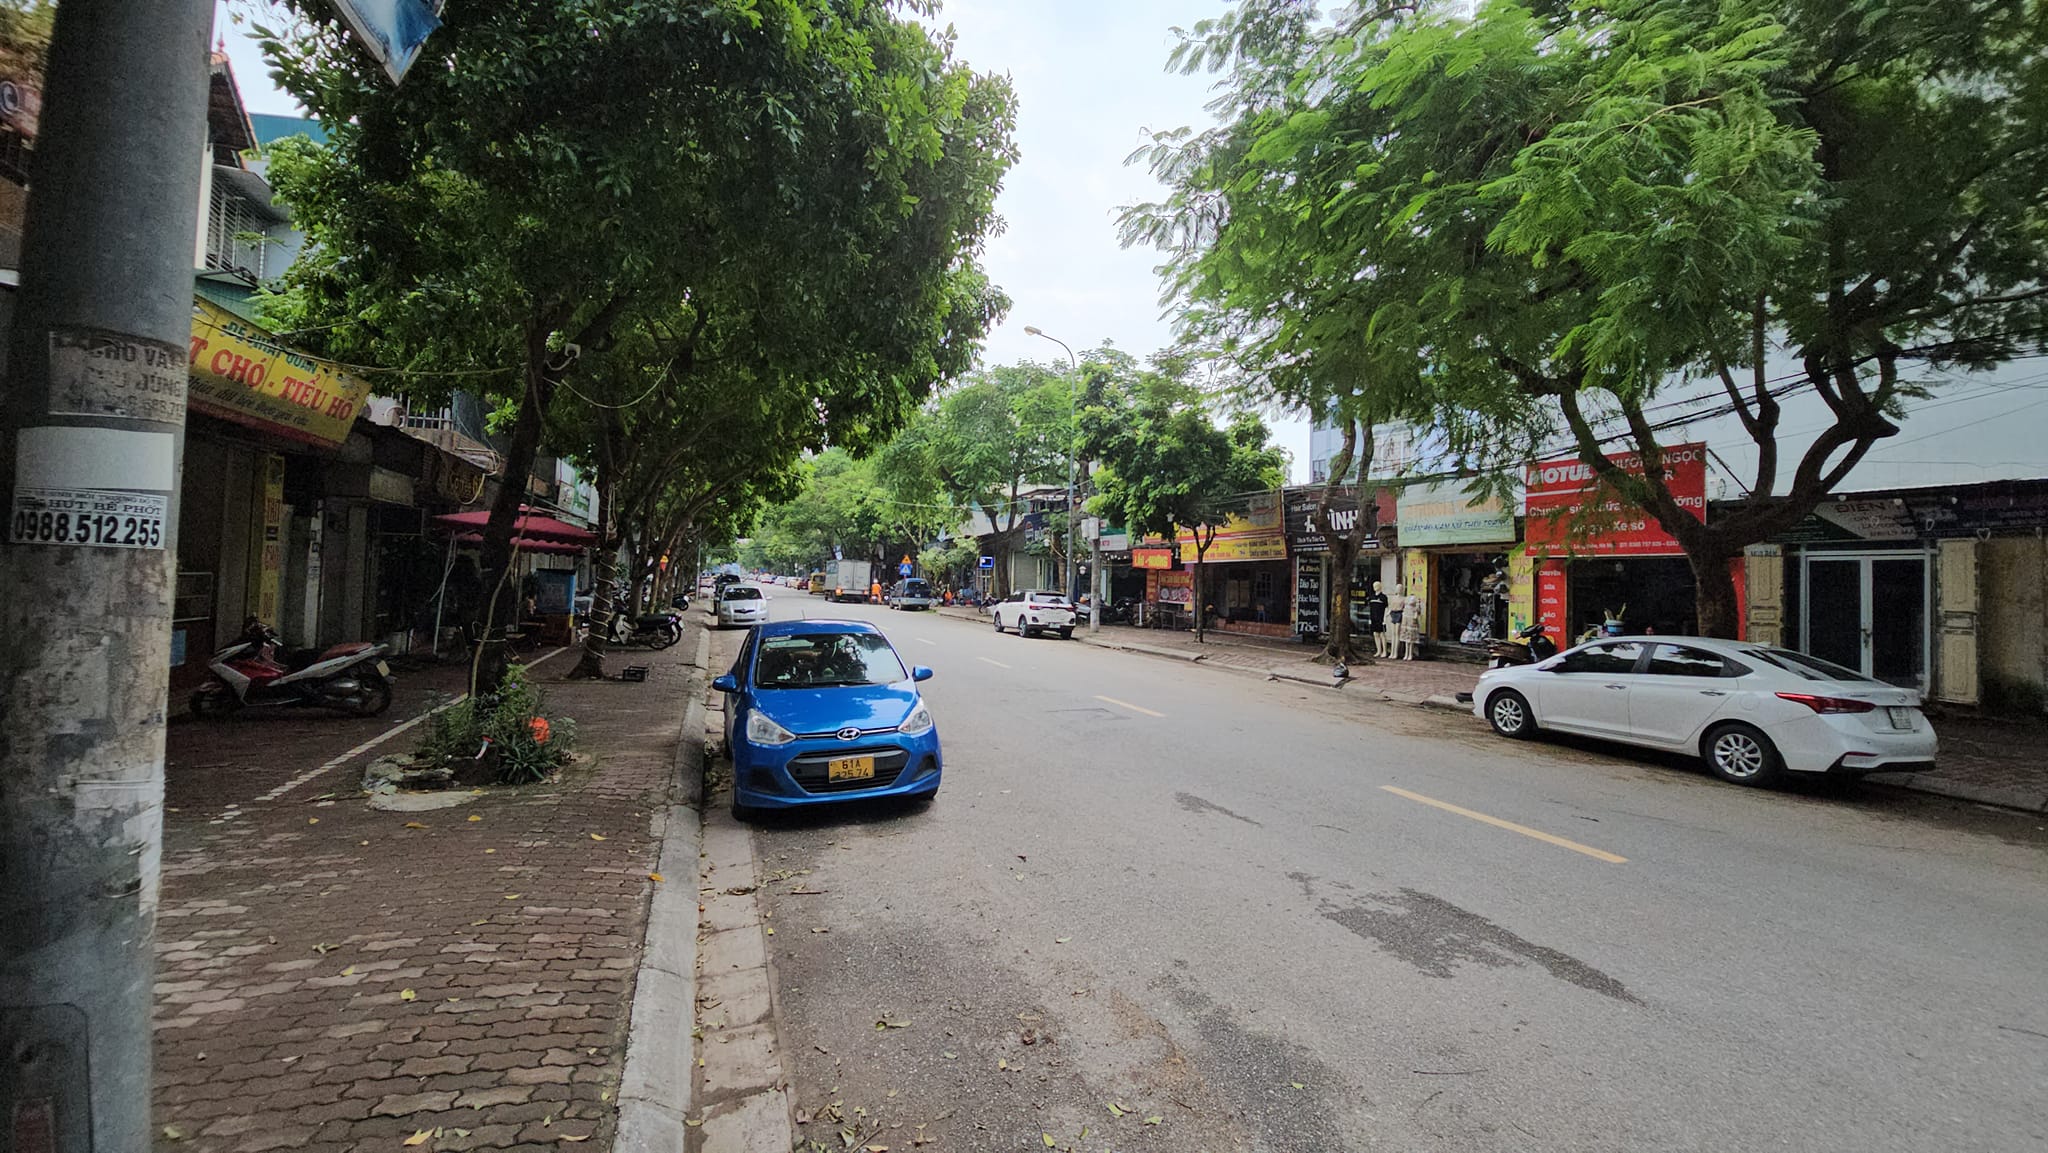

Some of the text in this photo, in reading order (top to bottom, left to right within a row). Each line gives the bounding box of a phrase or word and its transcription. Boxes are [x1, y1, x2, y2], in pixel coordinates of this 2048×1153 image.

[210, 349, 267, 387] CHÓ
[278, 373, 328, 411] TIỂU
[1527, 464, 1593, 486] MOTUL
[49, 499, 88, 509] HÚT
[15, 511, 160, 546] 0988.512.255
[1327, 508, 1359, 532] ÌNH
[1299, 621, 1318, 632] Tóc
[842, 760, 861, 769] 61A
